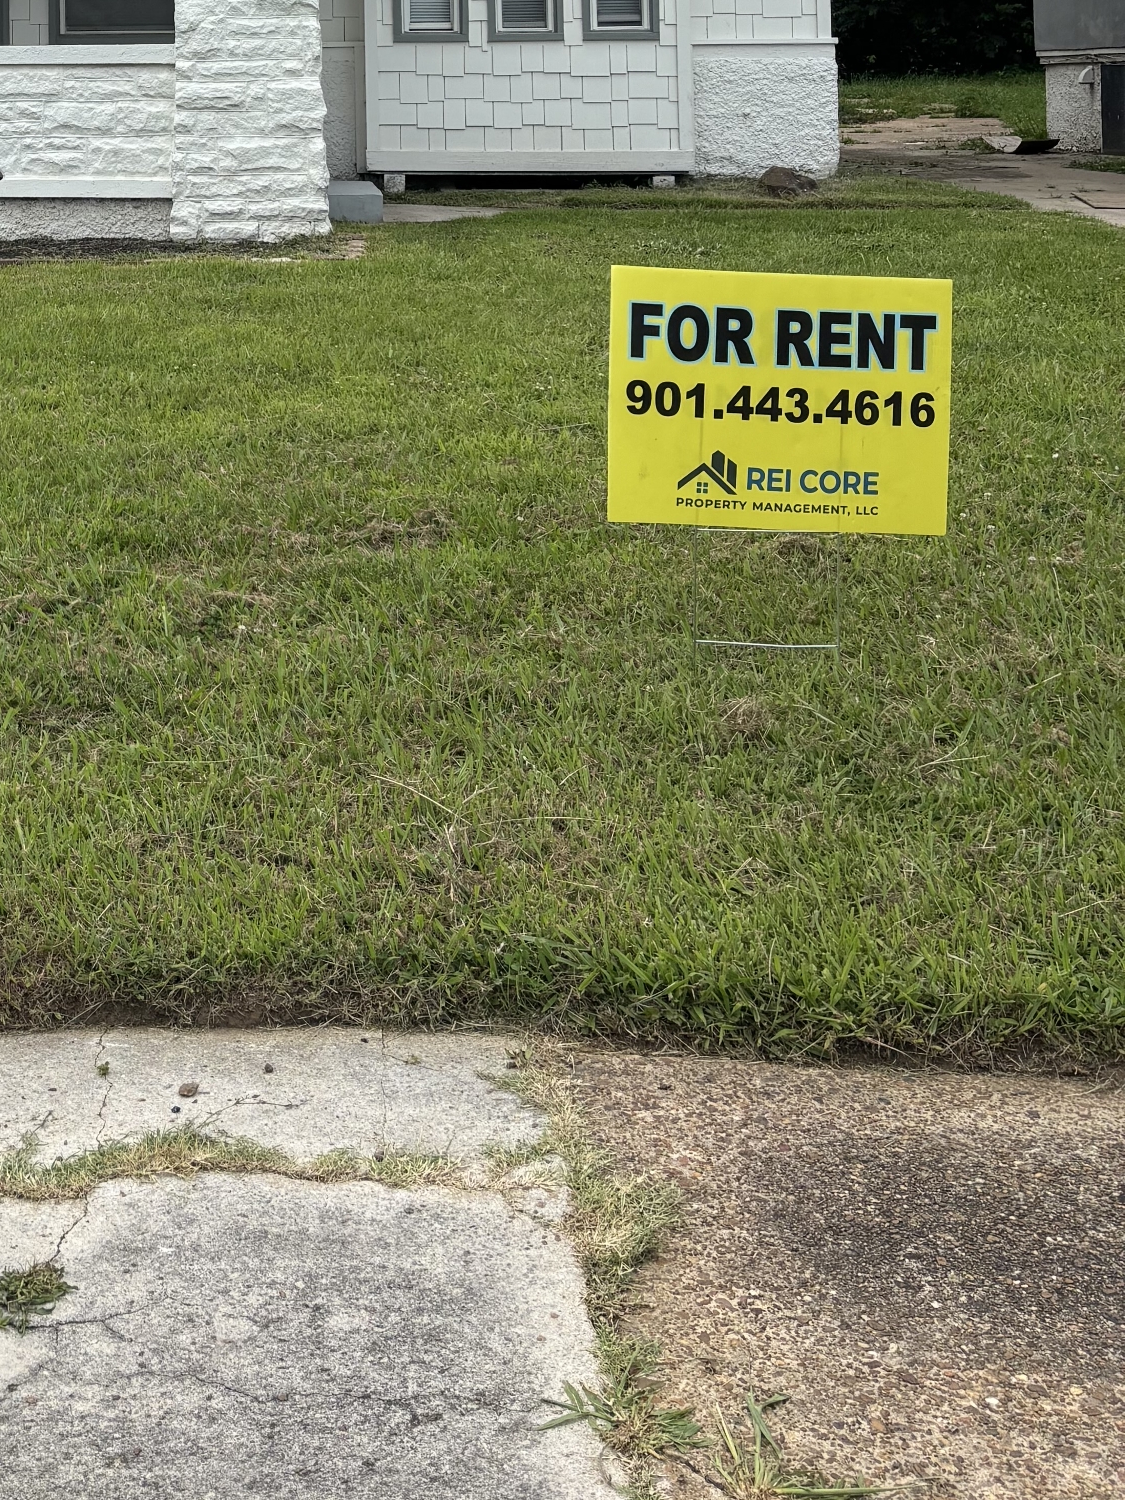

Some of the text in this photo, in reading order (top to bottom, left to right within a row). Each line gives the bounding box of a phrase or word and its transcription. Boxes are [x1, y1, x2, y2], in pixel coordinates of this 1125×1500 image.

[629, 301, 938, 373] FOR RENT
[626, 379, 935, 428] 901.443.4616
[746, 467, 880, 496] REI CORE
[676, 497, 879, 517] PROPERTY MANAGEMENT, LLC
